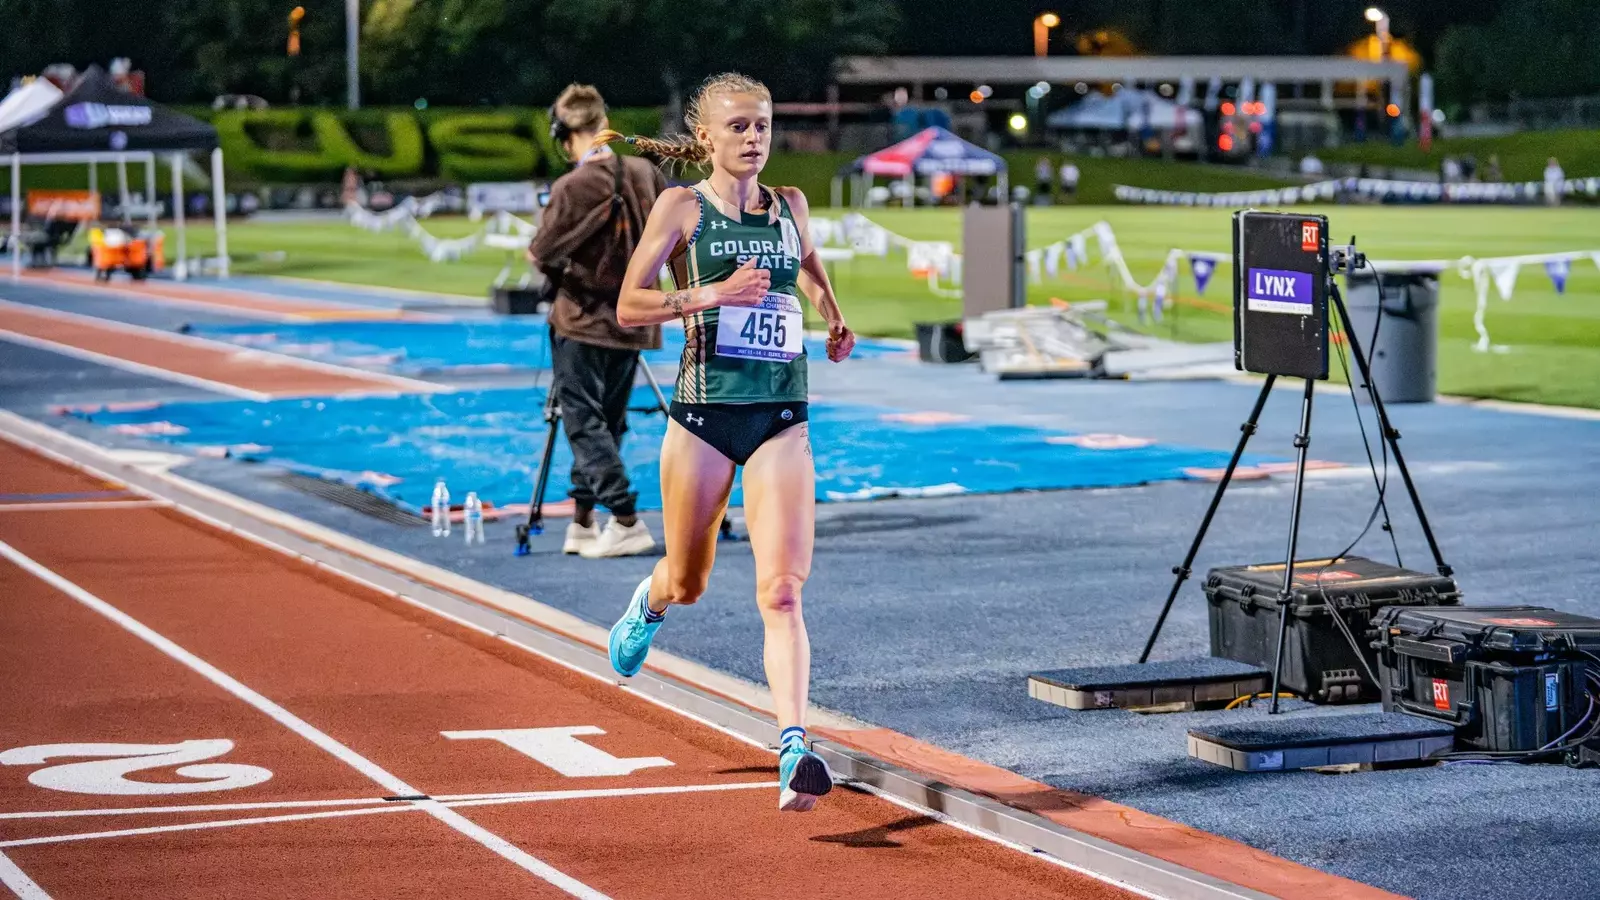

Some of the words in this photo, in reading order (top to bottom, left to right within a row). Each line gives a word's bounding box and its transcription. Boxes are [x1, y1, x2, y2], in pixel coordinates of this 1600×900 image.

[213, 109, 553, 177] CUS
[1302, 226, 1319, 244] RT
[710, 240, 787, 256] COLORA
[736, 255, 793, 269] STATE
[1255, 272, 1296, 297] LYNX
[740, 311, 787, 348] 455
[1432, 682, 1448, 701] RT
[440, 725, 676, 778] 1
[0, 737, 274, 796] 2
